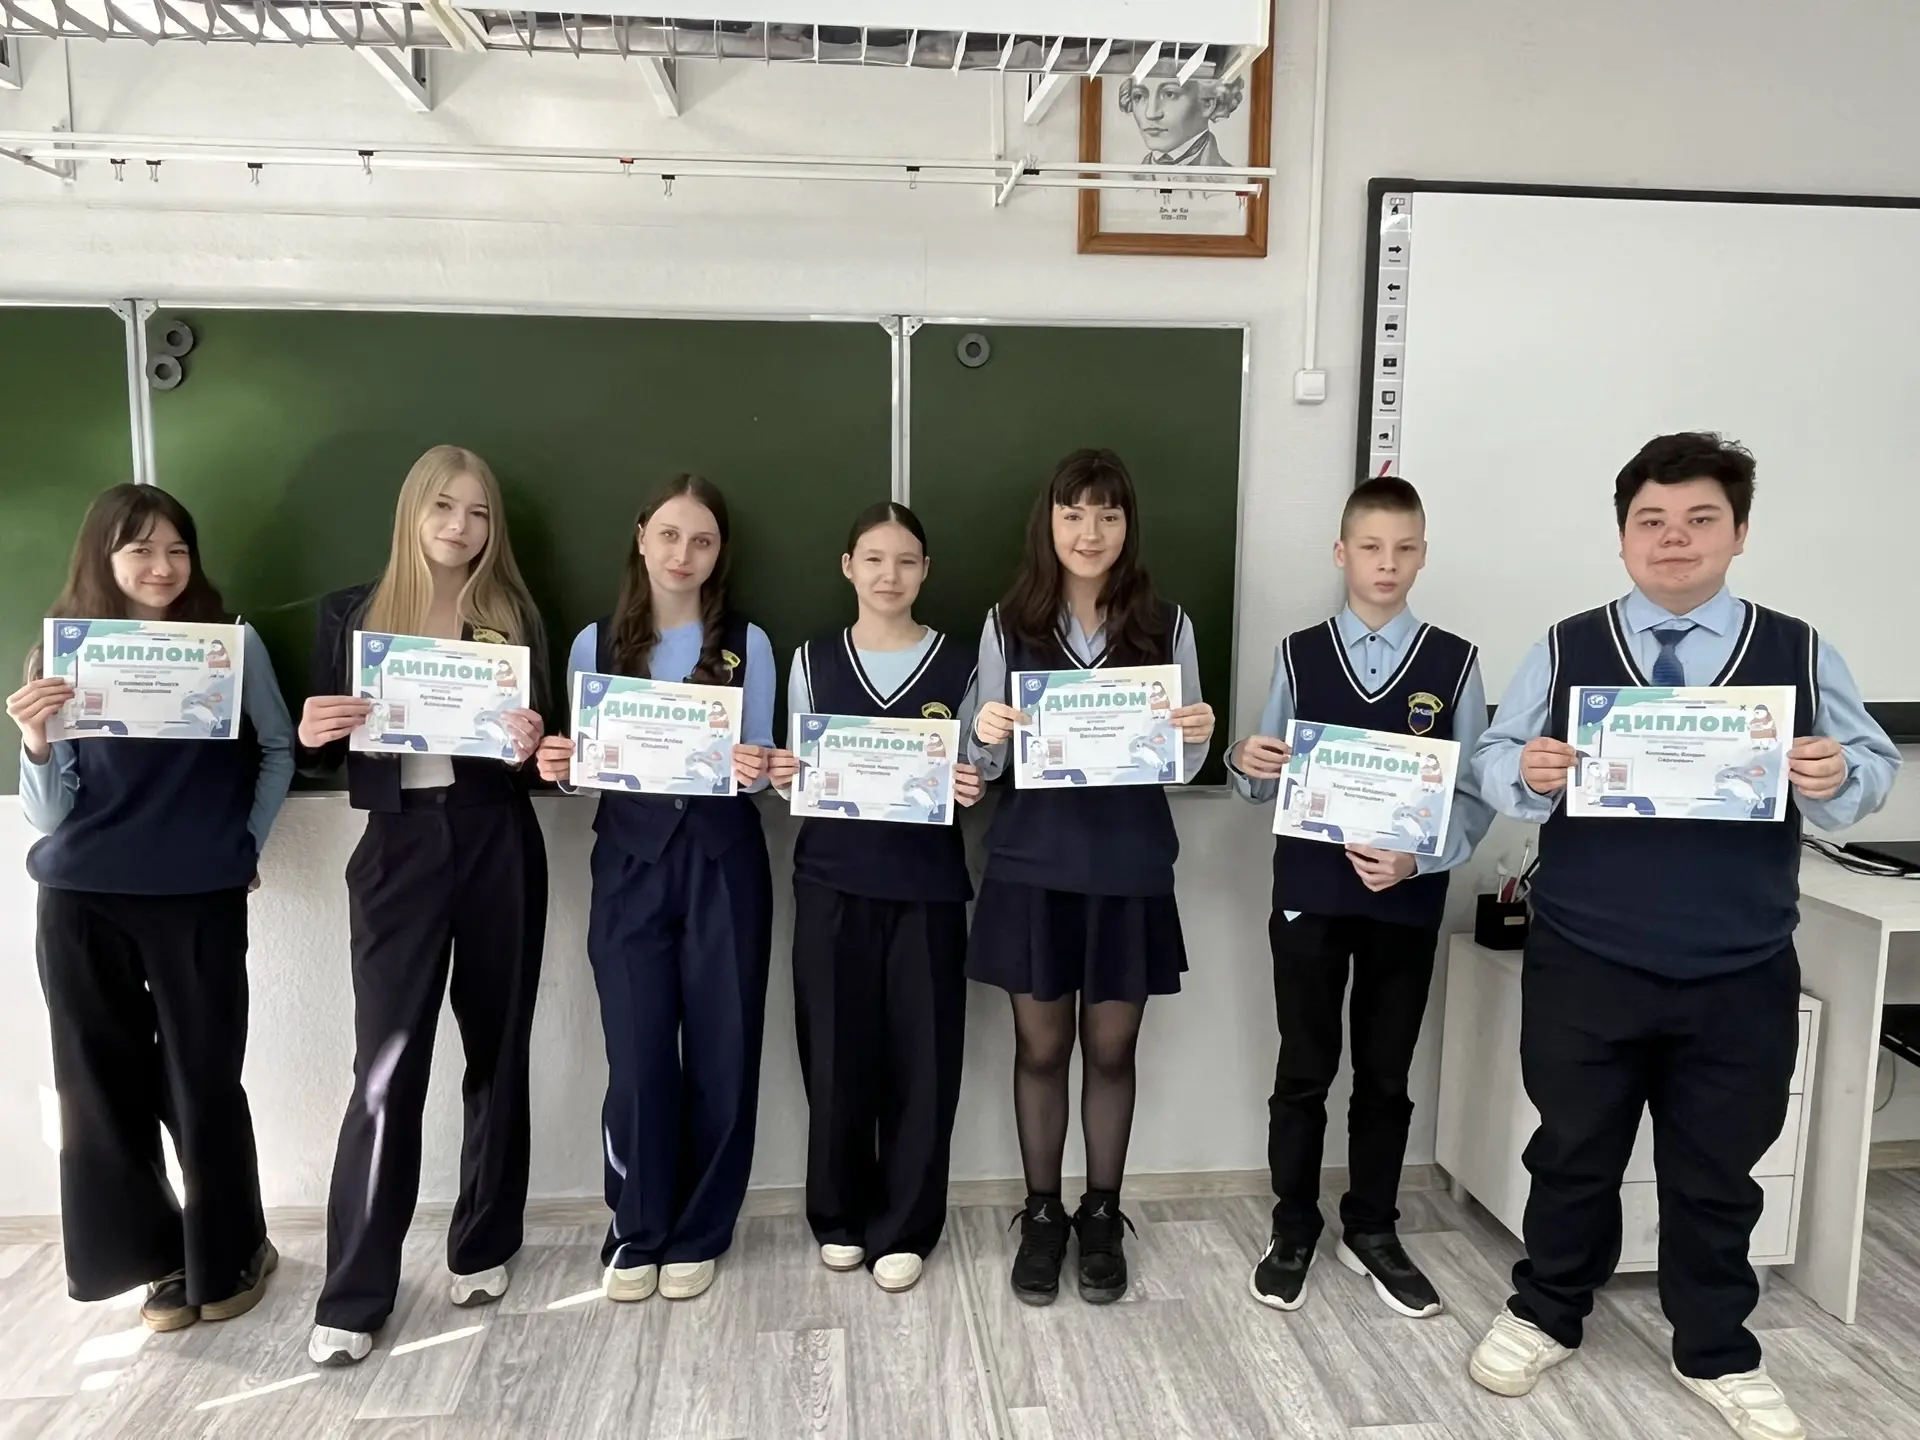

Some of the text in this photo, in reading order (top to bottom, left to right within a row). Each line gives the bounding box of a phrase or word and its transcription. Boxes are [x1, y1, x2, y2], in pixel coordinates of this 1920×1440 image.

[84, 643, 205, 663] ДИПЛОМ
[387, 658, 493, 681] ДИПЛОМ
[604, 700, 707, 723] ДИПЛОМ
[1044, 691, 1147, 712] ДИПЛОМ
[1609, 713, 1748, 733] ДИПЛОМ
[824, 735, 925, 752] ДИПЛОМ
[1314, 747, 1420, 776] ДИПЛОМ
